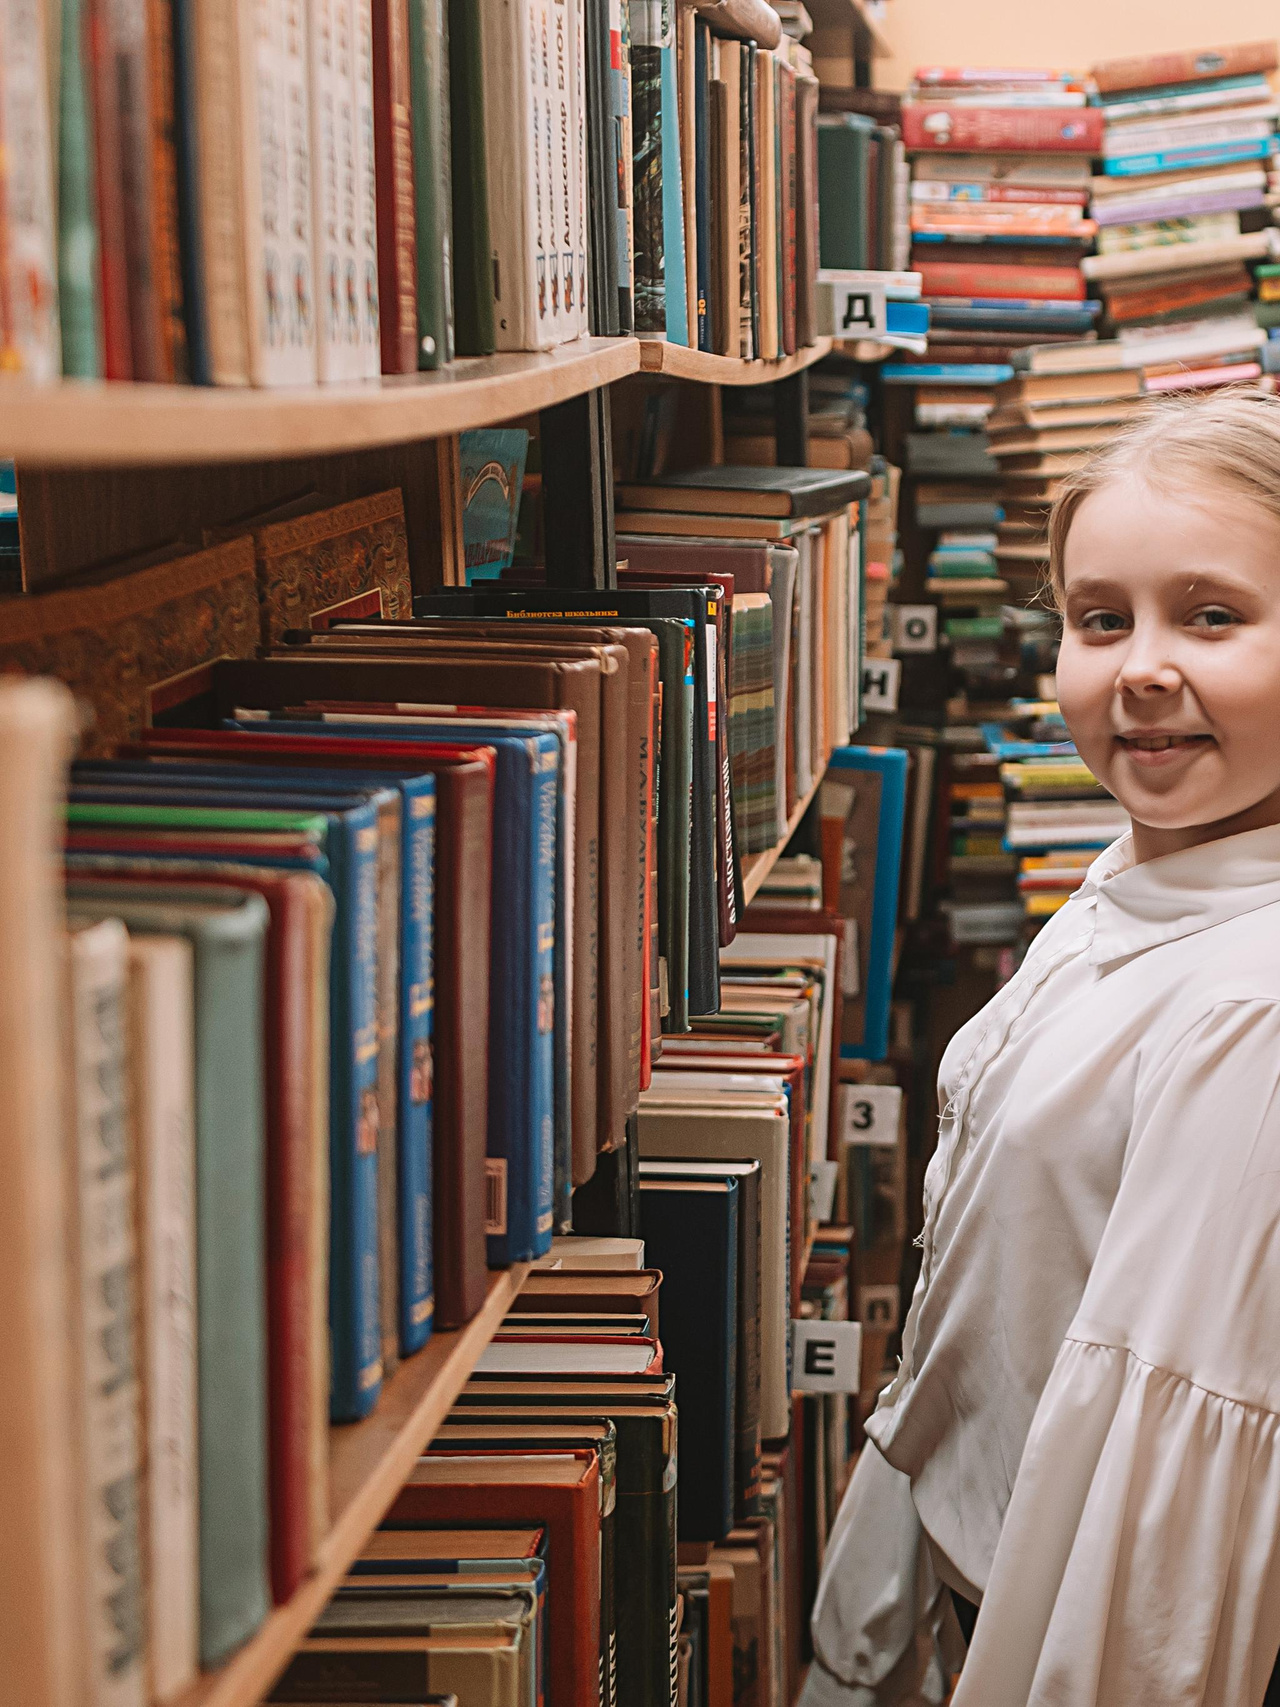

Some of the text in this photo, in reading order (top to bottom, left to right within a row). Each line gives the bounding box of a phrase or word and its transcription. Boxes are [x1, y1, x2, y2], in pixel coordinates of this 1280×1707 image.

[555, 14, 571, 247] Александр БЛОК
[698, 298, 706, 315] 20
[842, 293, 875, 329] Д
[507, 610, 618, 619] Библиотека школьника
[905, 617, 927, 641] О
[863, 668, 889, 696] Н
[804, 1339, 836, 1375] Е
